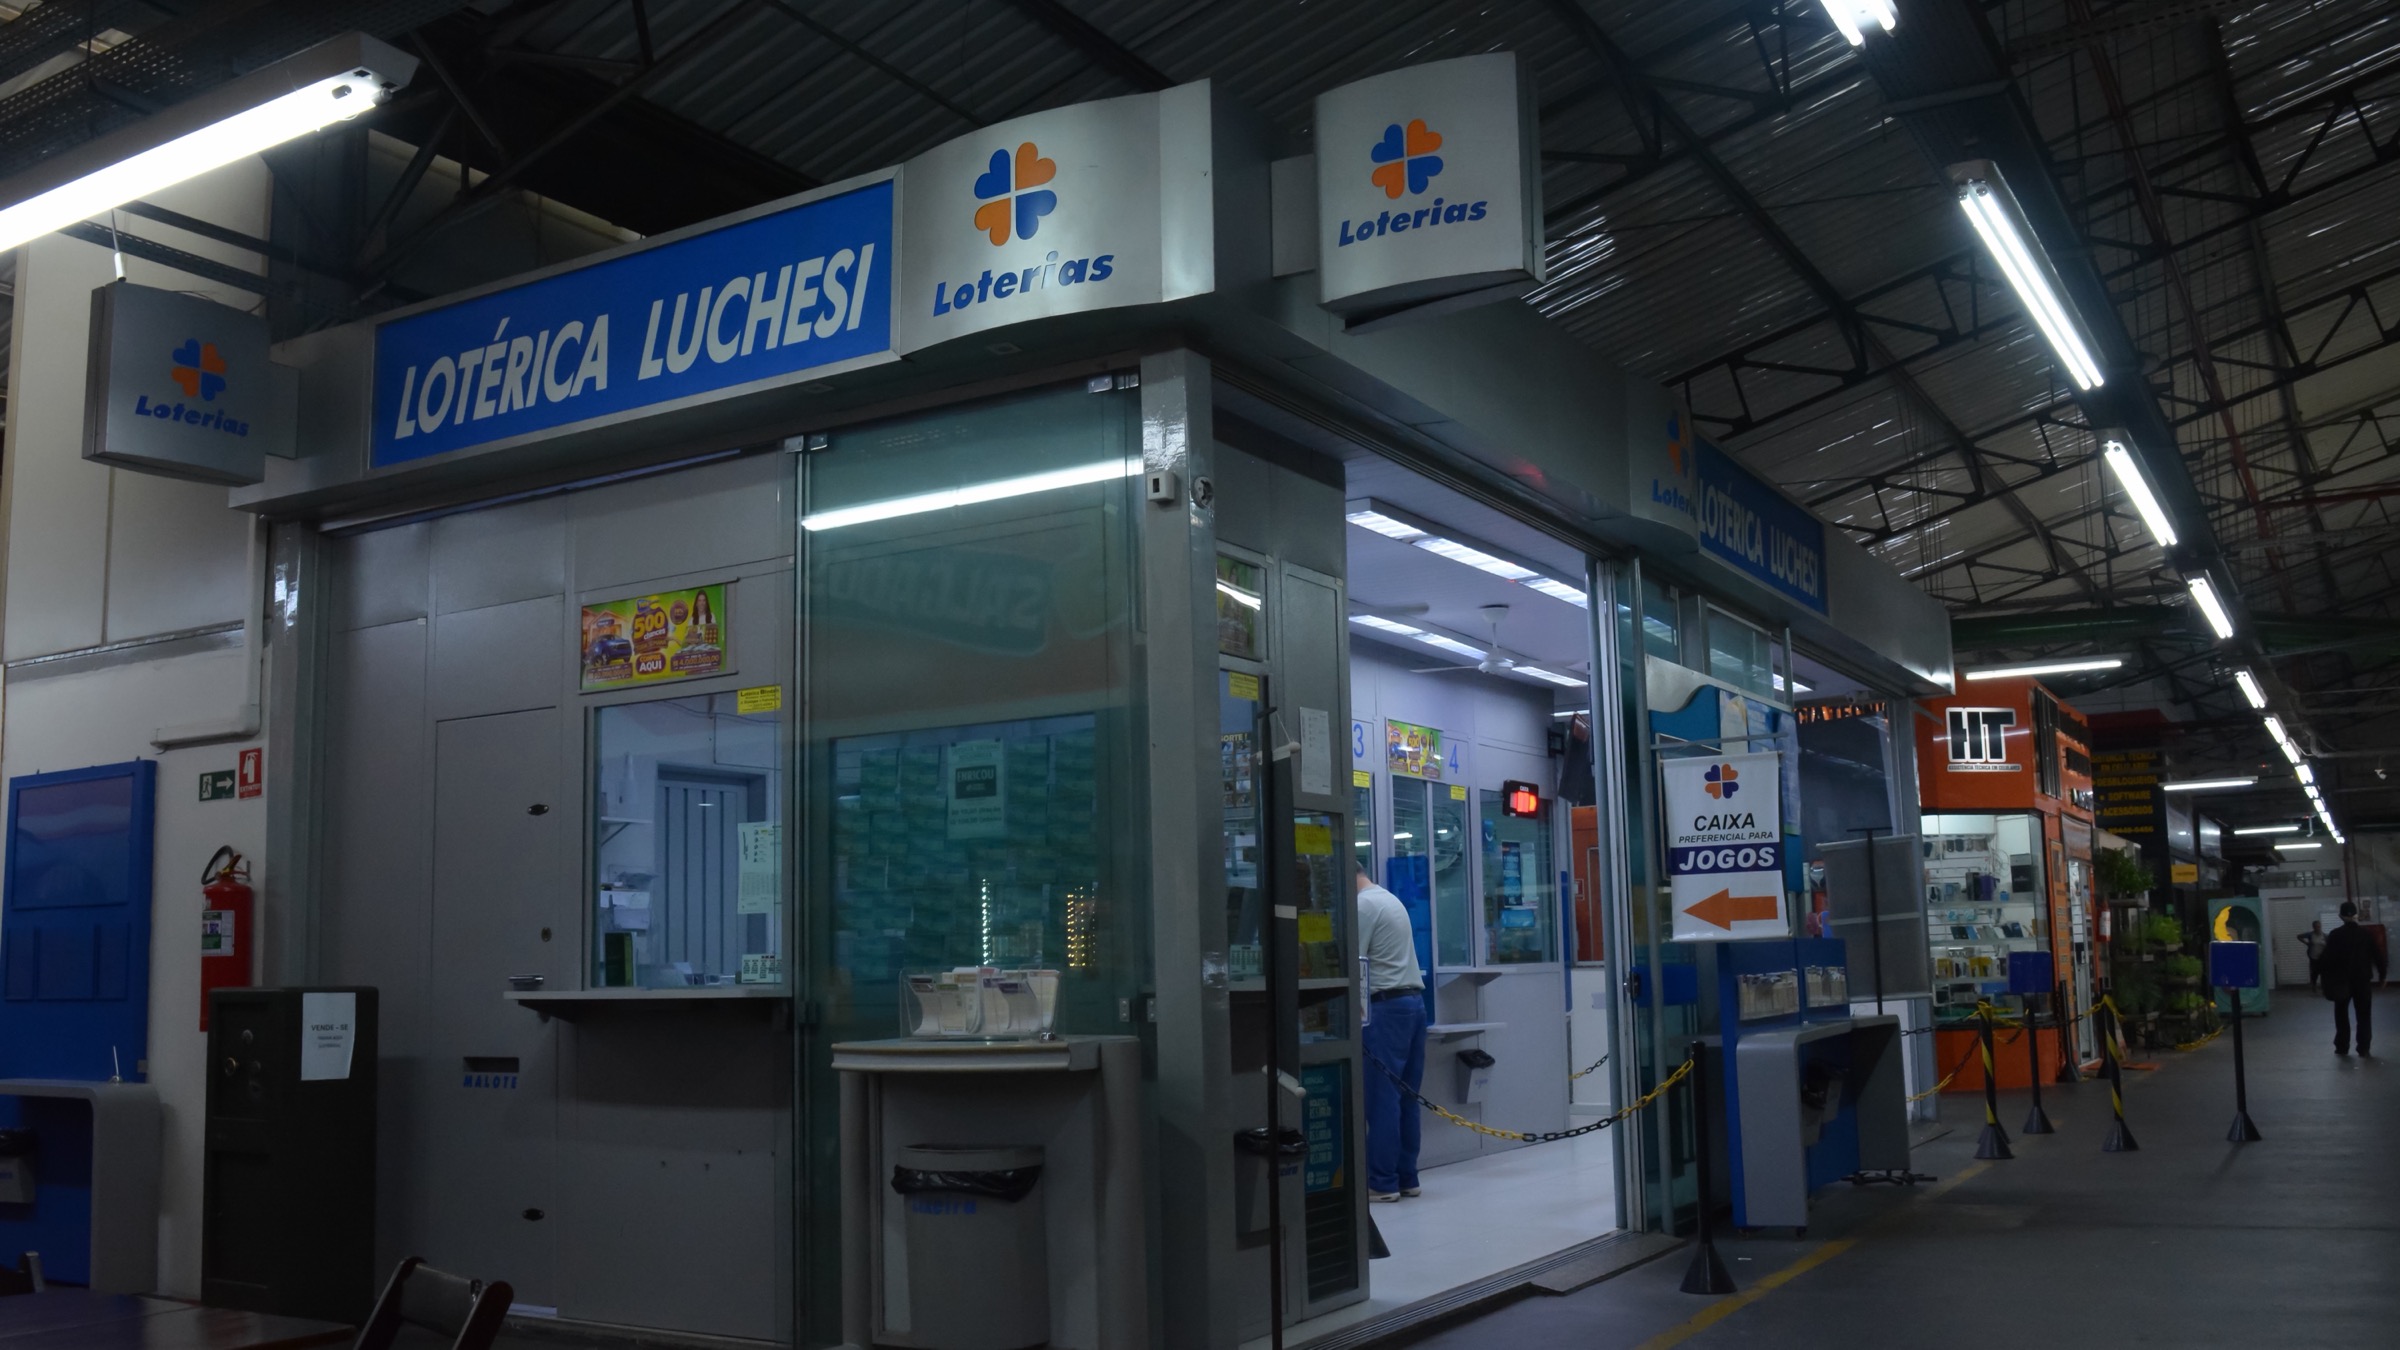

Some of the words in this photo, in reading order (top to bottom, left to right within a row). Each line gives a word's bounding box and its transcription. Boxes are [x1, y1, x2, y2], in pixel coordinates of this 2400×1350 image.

[1338, 197, 1488, 248] Loterias
[932, 250, 1115, 318] Loterias
[394, 314, 608, 441] LOTÉRICA
[638, 242, 876, 381] LUCHESI
[135, 395, 250, 437] Loterias
[1770, 525, 1819, 599] LUCHESI
[632, 611, 666, 640] 500
[639, 660, 663, 673] AQUI
[1353, 722, 1365, 759] 3
[1449, 743, 1460, 774] 4
[2108, 790, 2152, 801] SOFTWARE
[1694, 813, 1756, 831] CAIXA
[1679, 833, 1746, 844] PREFERENCIAL
[1749, 831, 1774, 840] PARA
[1678, 846, 1776, 872] JOGOS
[311, 1024, 334, 1032] VENDE
[463, 1074, 518, 1089] MALOTE
